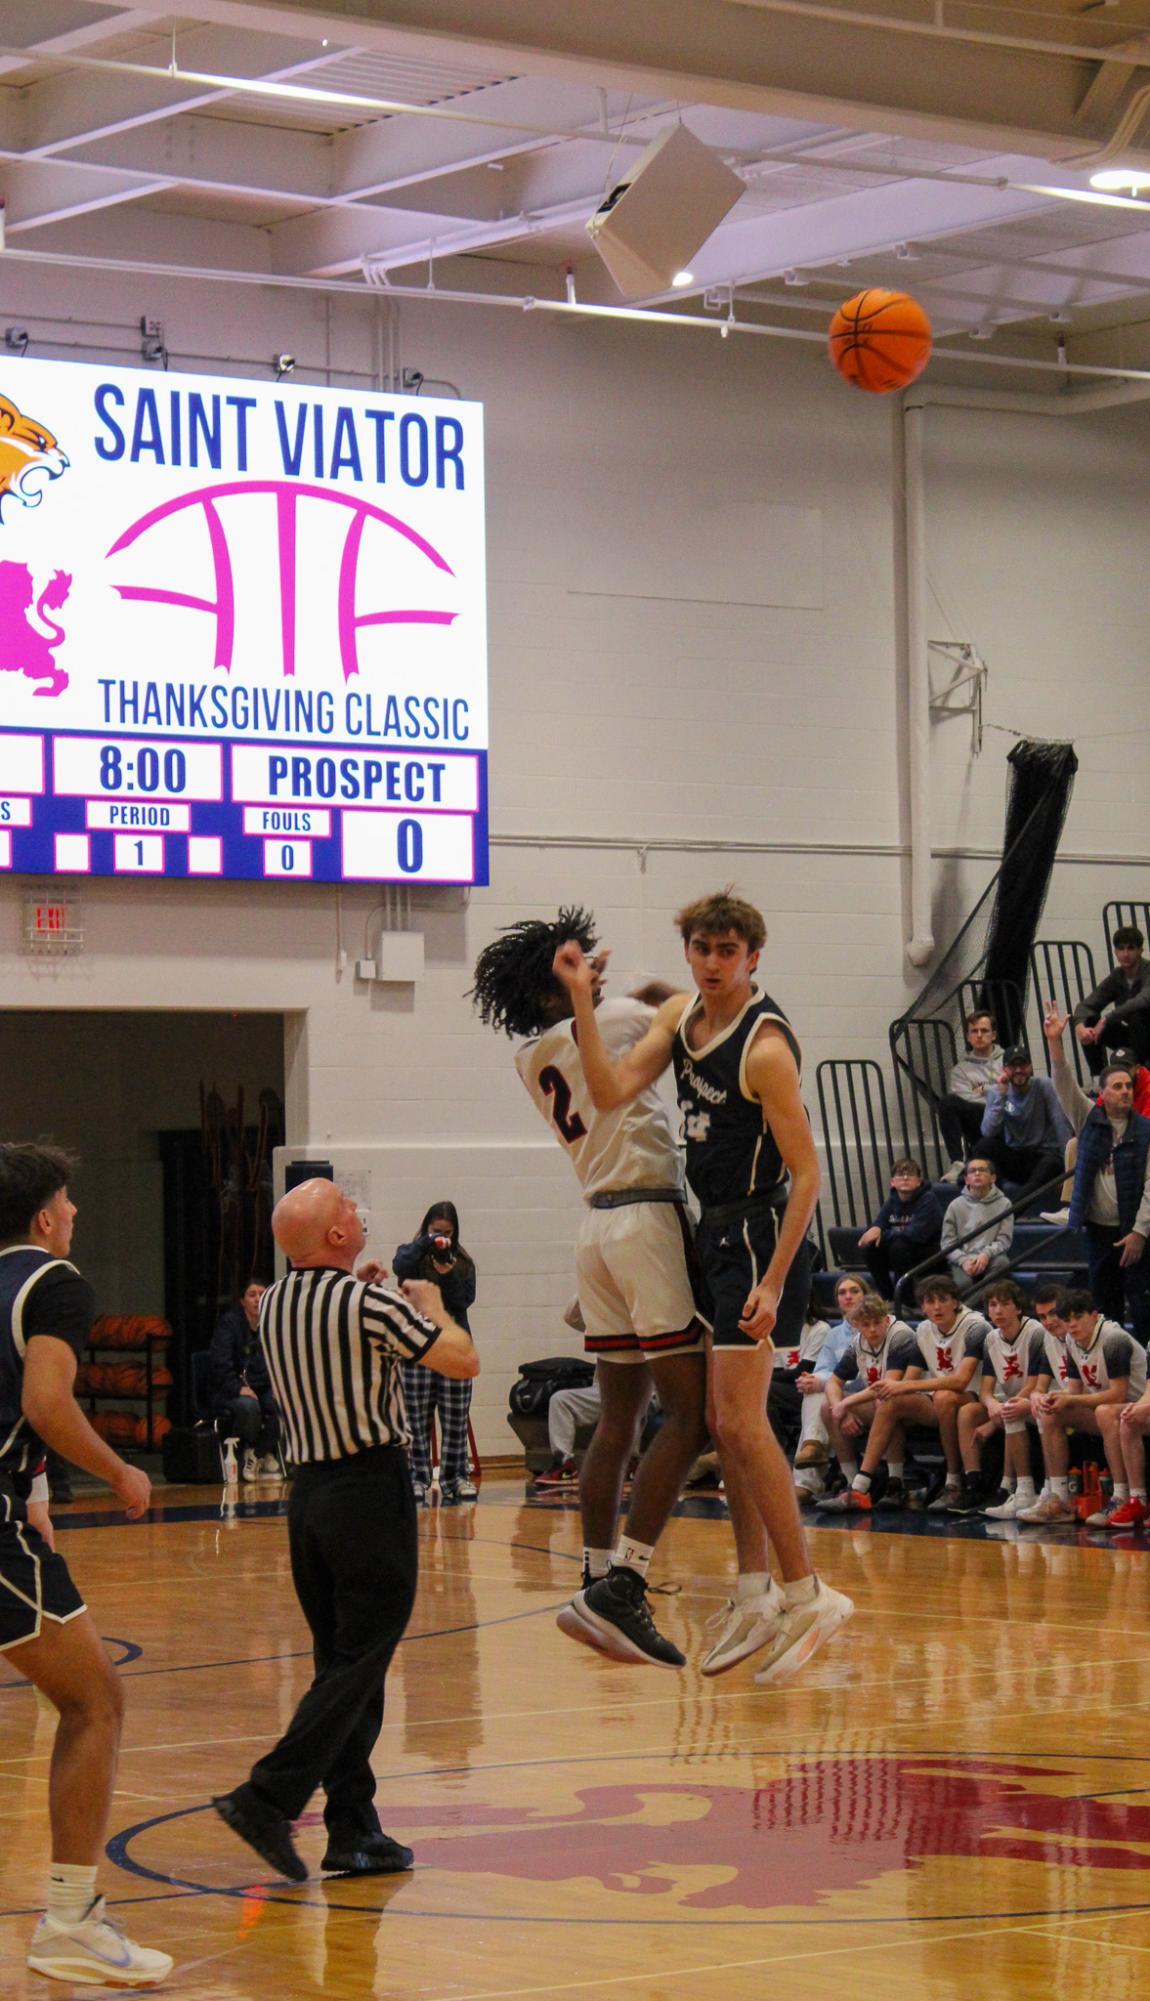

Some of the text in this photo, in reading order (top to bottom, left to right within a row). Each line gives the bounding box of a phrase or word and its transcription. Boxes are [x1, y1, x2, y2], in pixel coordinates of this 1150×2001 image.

[93, 383, 465, 491] SAINT VIATOR
[97, 678, 470, 741] THANKSGIVING CLASSIC
[99, 745, 187, 793] 8:00
[267, 755, 447, 802] PROSPECT
[109, 805, 170, 827] PERIOD
[262, 811, 312, 832] FOULS
[133, 840, 144, 866] 1
[281, 844, 295, 871] 0
[397, 818, 424, 873] 0
[538, 1065, 588, 1144] 2
